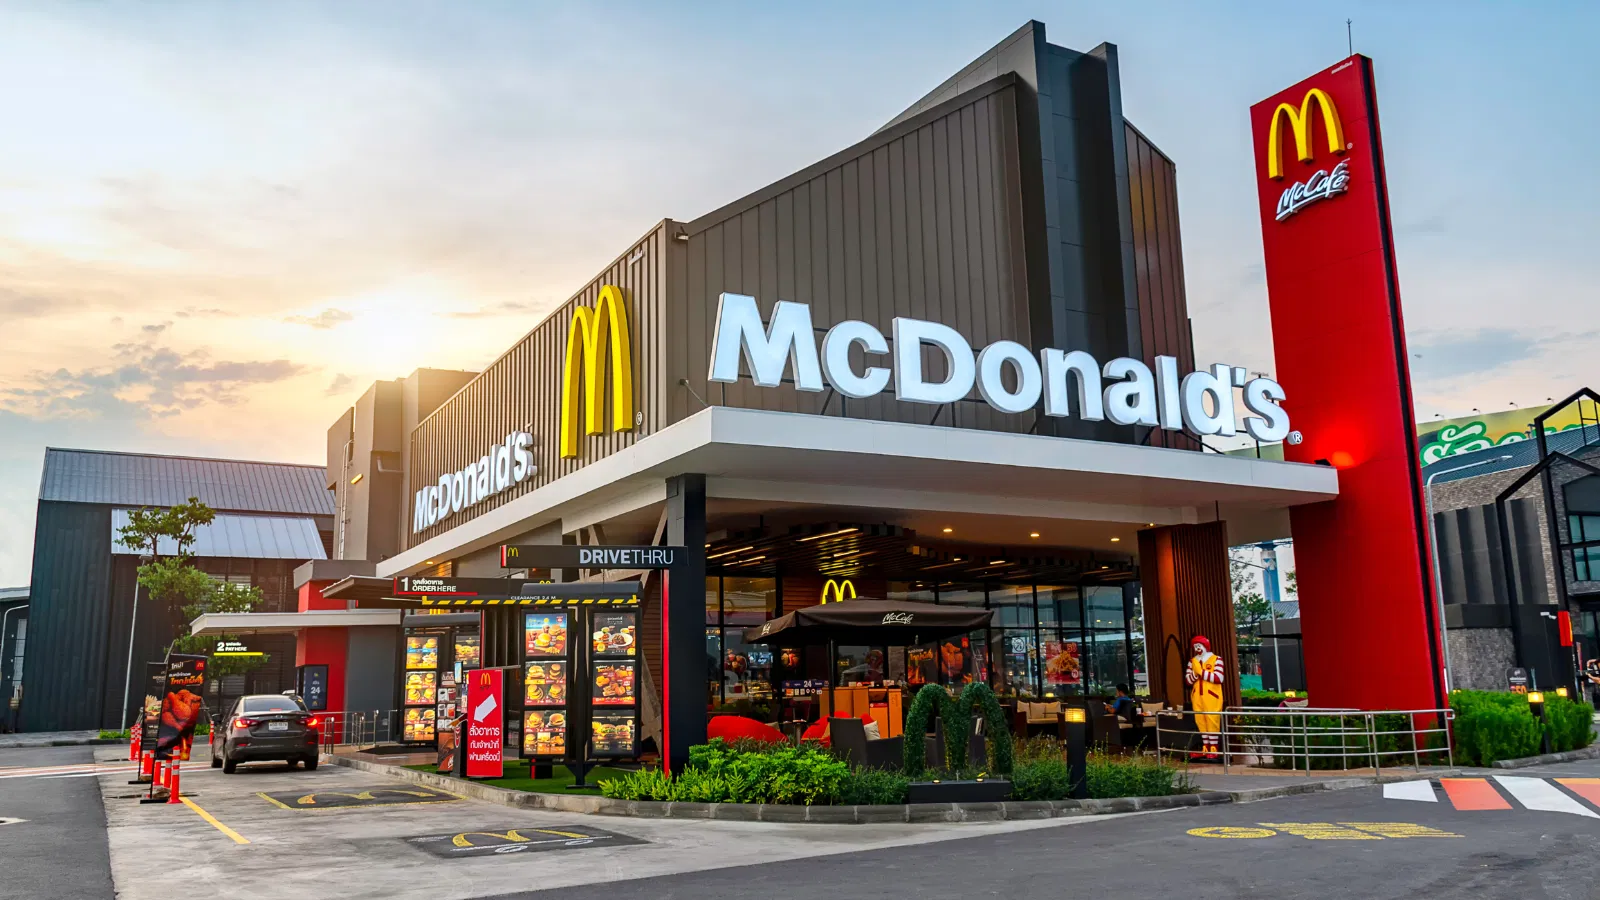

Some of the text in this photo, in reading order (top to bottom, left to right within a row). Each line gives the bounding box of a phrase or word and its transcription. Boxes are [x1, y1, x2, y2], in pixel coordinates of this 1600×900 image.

[1275, 158, 1350, 222] McCafé
[707, 291, 1292, 443] McDonald's
[413, 429, 534, 535] McDonald's
[401, 576, 409, 592] 1
[216, 641, 225, 652] 2
[310, 686, 321, 694] 24
[803, 680, 812, 688] 24
[469, 722, 501, 737] สั่งอาหาร
[469, 738, 500, 749] กับเจ้าหน้าที่
